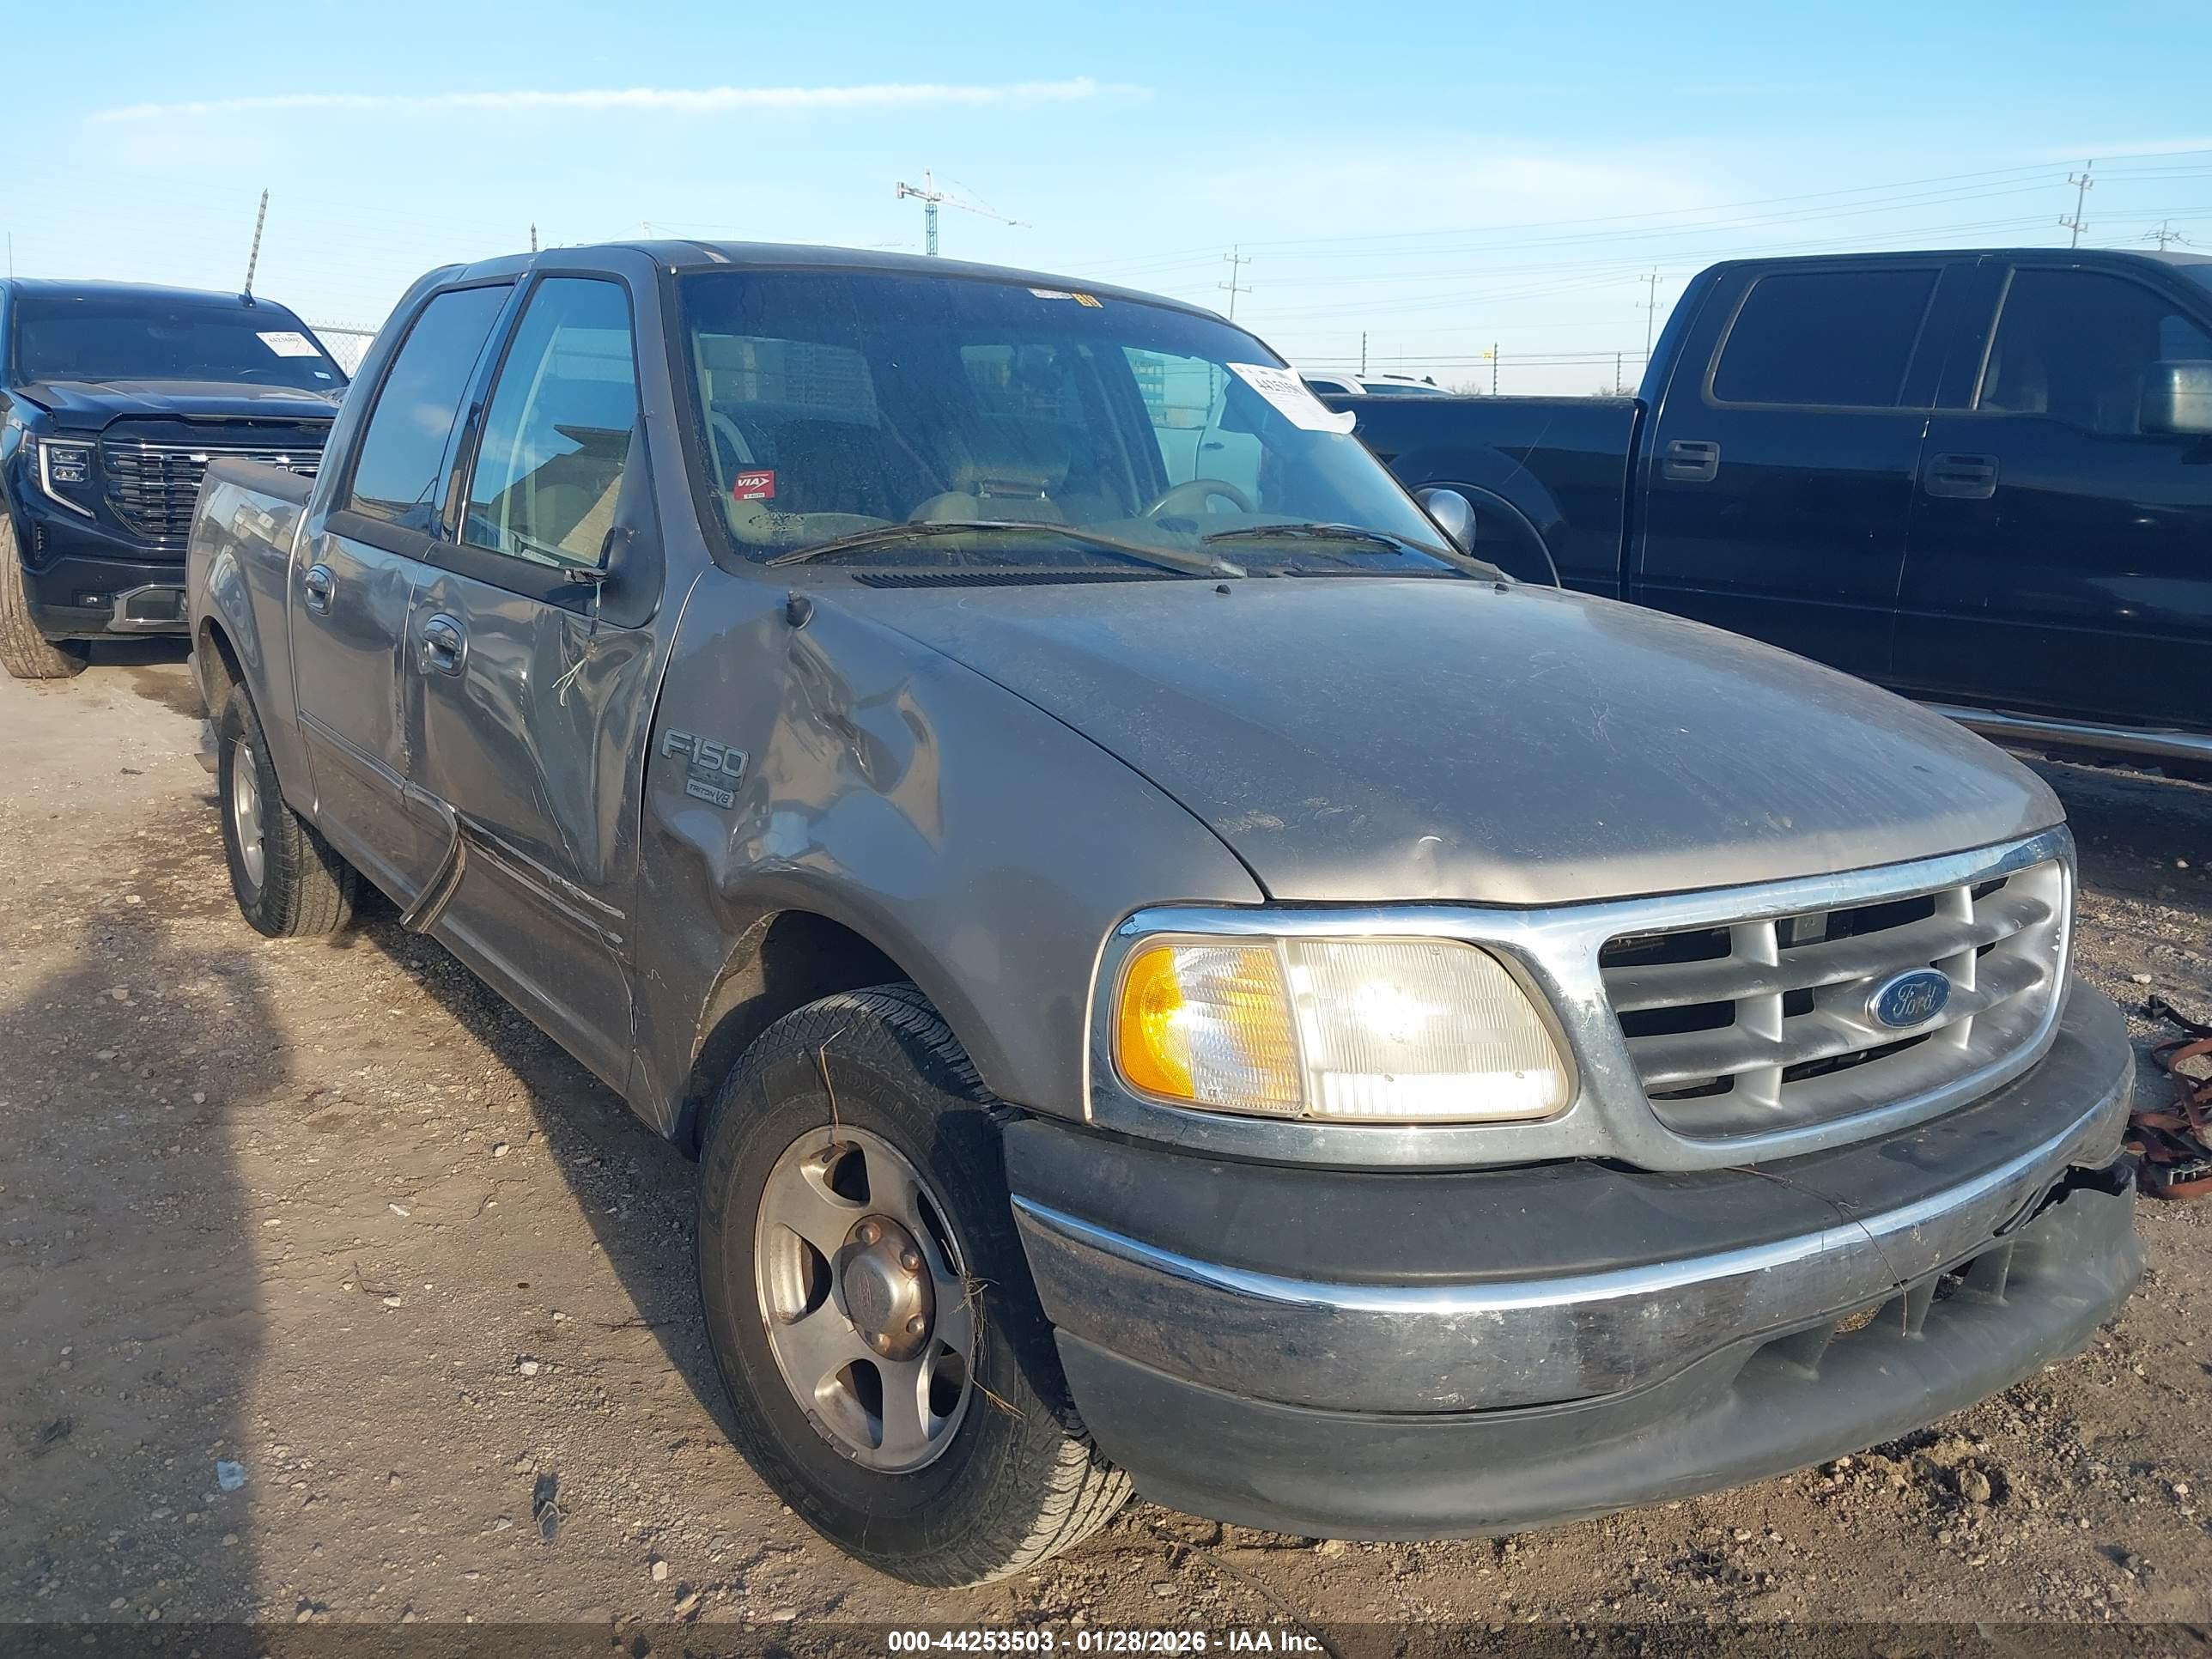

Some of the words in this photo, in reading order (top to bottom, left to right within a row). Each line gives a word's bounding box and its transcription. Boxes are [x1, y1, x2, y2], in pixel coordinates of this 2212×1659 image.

[689, 783, 716, 799] TRITON
[715, 791, 731, 805] V8
[1893, 981, 1938, 1018] Ford
